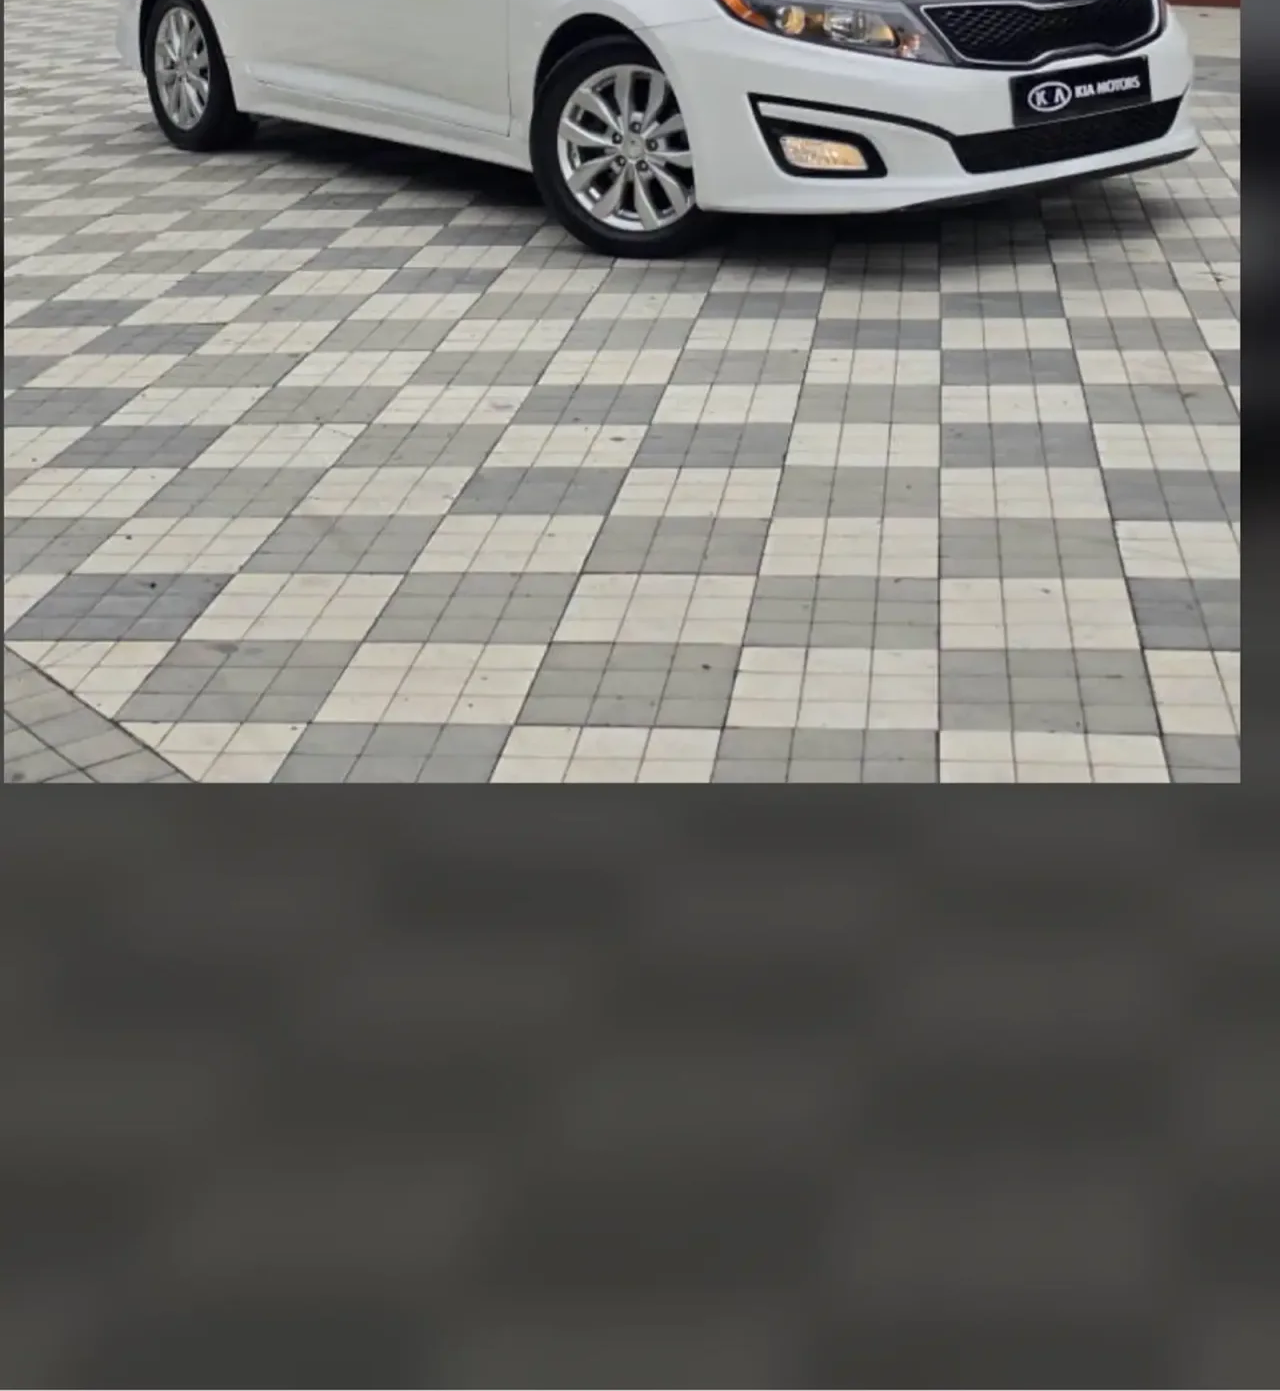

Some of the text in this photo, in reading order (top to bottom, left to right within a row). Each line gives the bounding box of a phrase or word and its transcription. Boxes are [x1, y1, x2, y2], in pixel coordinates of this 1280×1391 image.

[1033, 86, 1069, 107] KA
[1074, 75, 1140, 98] KIA MOTORS
